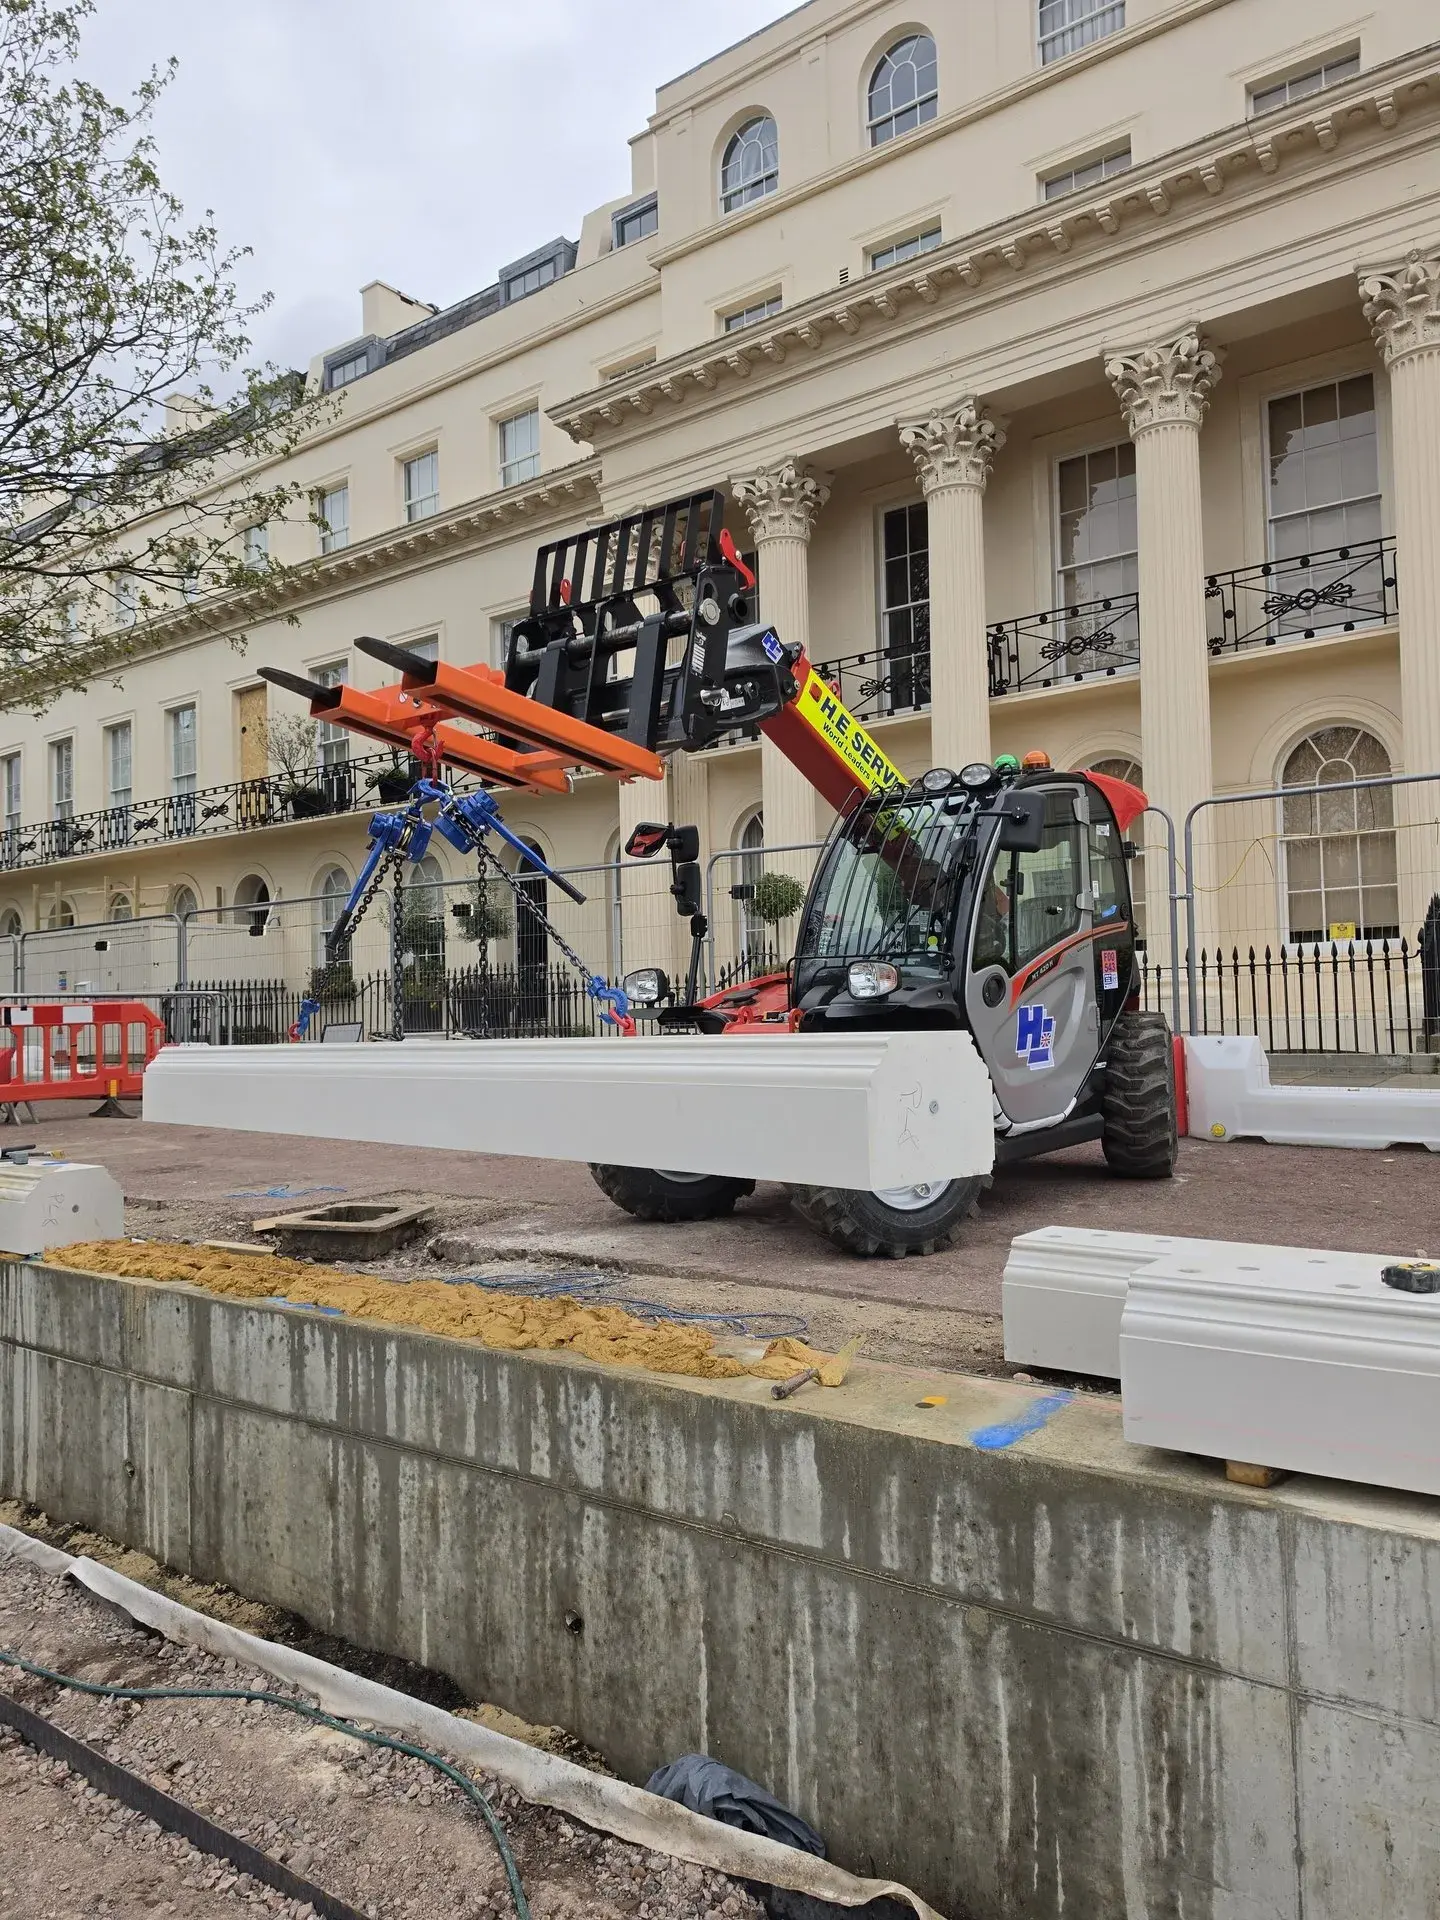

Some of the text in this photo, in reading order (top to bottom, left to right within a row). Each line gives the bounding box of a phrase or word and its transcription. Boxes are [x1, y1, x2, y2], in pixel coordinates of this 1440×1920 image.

[820, 697, 850, 739] H.E.
[822, 721, 844, 748] World
[844, 746, 871, 780] Leaders
[1031, 971, 1040, 981] MT
